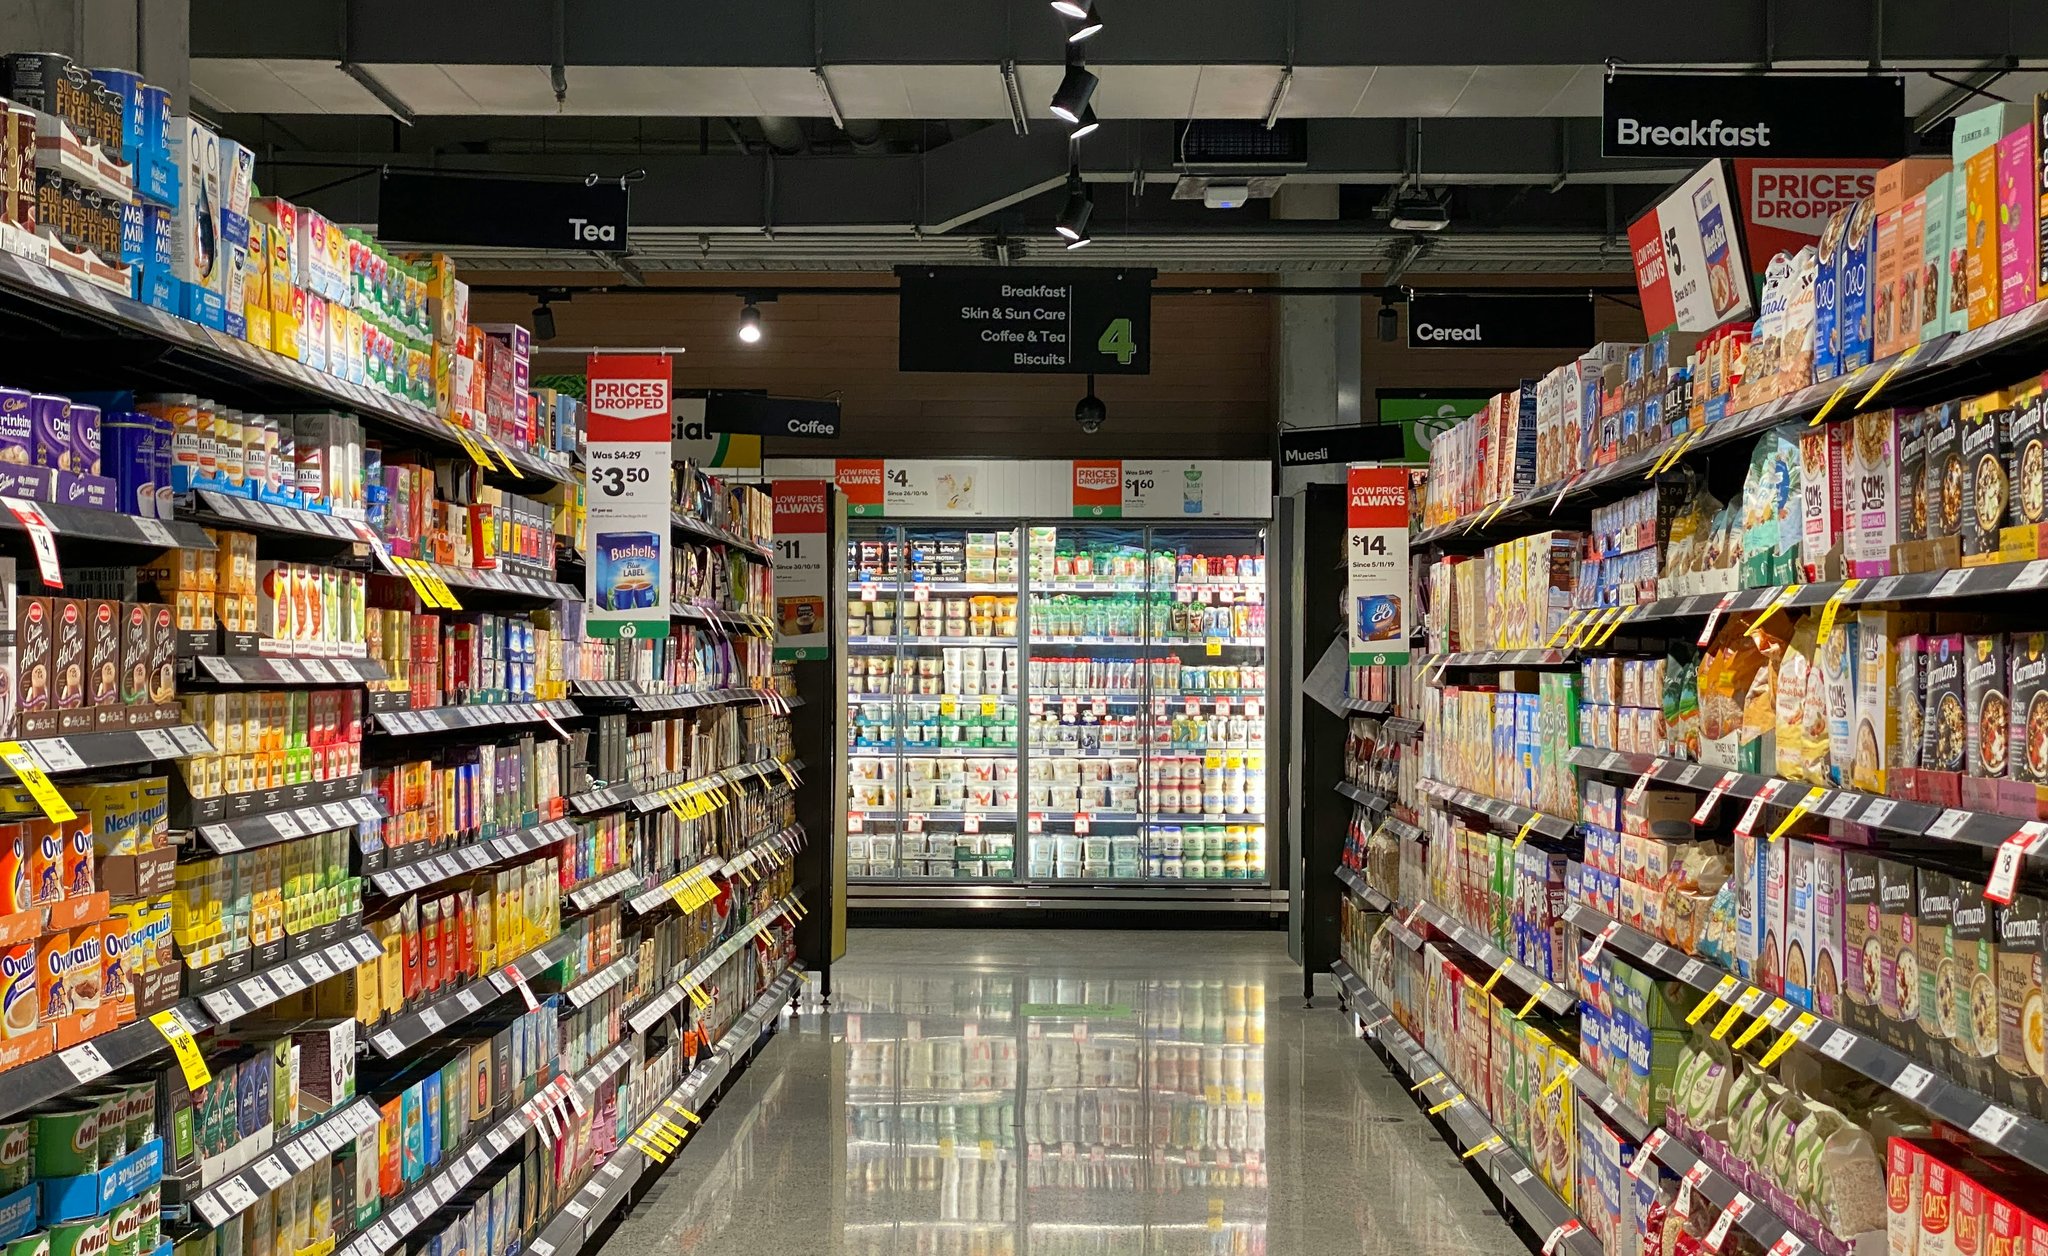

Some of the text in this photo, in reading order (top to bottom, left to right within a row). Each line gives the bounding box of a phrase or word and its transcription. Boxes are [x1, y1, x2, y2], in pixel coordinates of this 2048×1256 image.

[1617, 118, 1770, 147] Breakfast
[1757, 174, 1875, 199] PRICES
[1757, 200, 1853, 219] DROPP
[569, 218, 615, 242] Tea
[1635, 236, 1661, 266] LOW PRICE
[1664, 226, 1682, 276] $5
[1639, 256, 1665, 289] ALWAYS
[1001, 285, 1066, 297] Breakfast
[1674, 288, 1685, 303] Since
[961, 307, 1066, 320] Skin & Sun Care
[981, 329, 1066, 342] Coffee & Tea
[1098, 318, 1137, 364] 4
[1416, 323, 1482, 342] Cereal
[1014, 352, 1066, 365] Biscuits
[595, 383, 664, 398] PRICES
[595, 398, 664, 409] DROPPED
[787, 419, 835, 435] Coffee
[2008, 398, 2041, 442] Carman's
[1962, 414, 1994, 455] Carman's
[592, 450, 641, 460] Was $4.29
[1285, 448, 1328, 462] Muesli
[839, 475, 881, 485] ALWAYS
[887, 469, 908, 487] $4
[1079, 469, 1117, 478] PRICES
[797, 495, 823, 503] PRICE
[1352, 486, 1405, 495] LOW PRICE
[775, 503, 824, 513] ALWAYS
[1351, 495, 1406, 506] ALWAYS
[611, 544, 656, 561] Bushells
[776, 540, 800, 559] $11
[1352, 535, 1387, 556] $14
[623, 569, 645, 577] LABEL
[1371, 609, 1393, 623] GO
[2012, 652, 2046, 685] Carman's
[1847, 867, 1876, 893] Carman's
[1880, 875, 1910, 902] Carman's
[1952, 898, 1986, 927] Carman's
[1629, 1031, 1649, 1070] Weet-Bix
[4, 1137, 29, 1160] MIL
[1889, 1172, 1907, 1199] OATS
[1924, 1191, 1947, 1220] OATS
[1957, 1210, 1976, 1240] OATS
